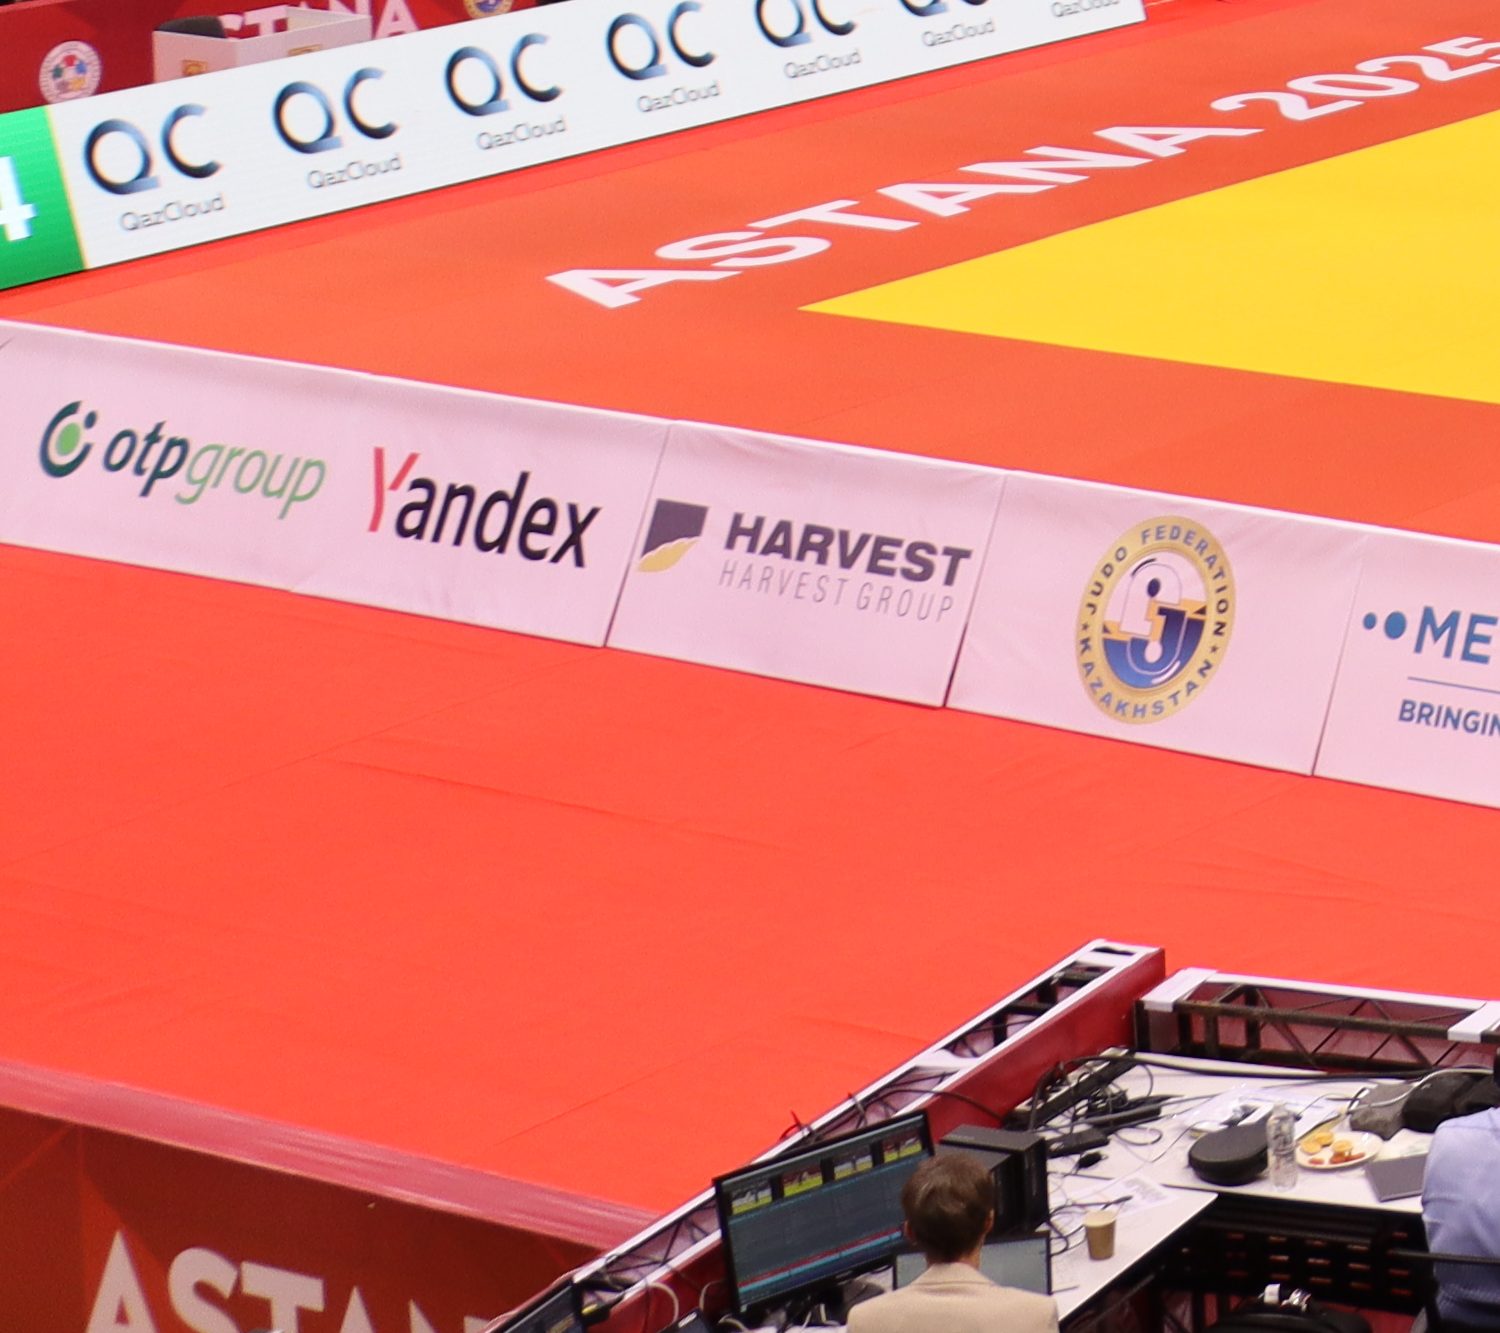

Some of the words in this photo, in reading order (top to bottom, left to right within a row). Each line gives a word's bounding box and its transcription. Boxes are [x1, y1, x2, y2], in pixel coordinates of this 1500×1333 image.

[636, 80, 721, 113] QazCloud
[784, 49, 861, 79] QazCloud
[475, 117, 567, 151] QazCloud
[307, 153, 402, 189] QazCloud
[120, 194, 226, 232] QazCloud
[545, 124, 1264, 309] ASTANA
[101, 420, 326, 519] otpgroup
[370, 446, 601, 570] Yandex
[724, 512, 972, 587] HARVEST
[1086, 546, 1127, 615] JUDO
[718, 559, 851, 611] HARVEST
[856, 580, 955, 624] GROUP
[1080, 637, 1213, 718] KAZAKHSTAN
